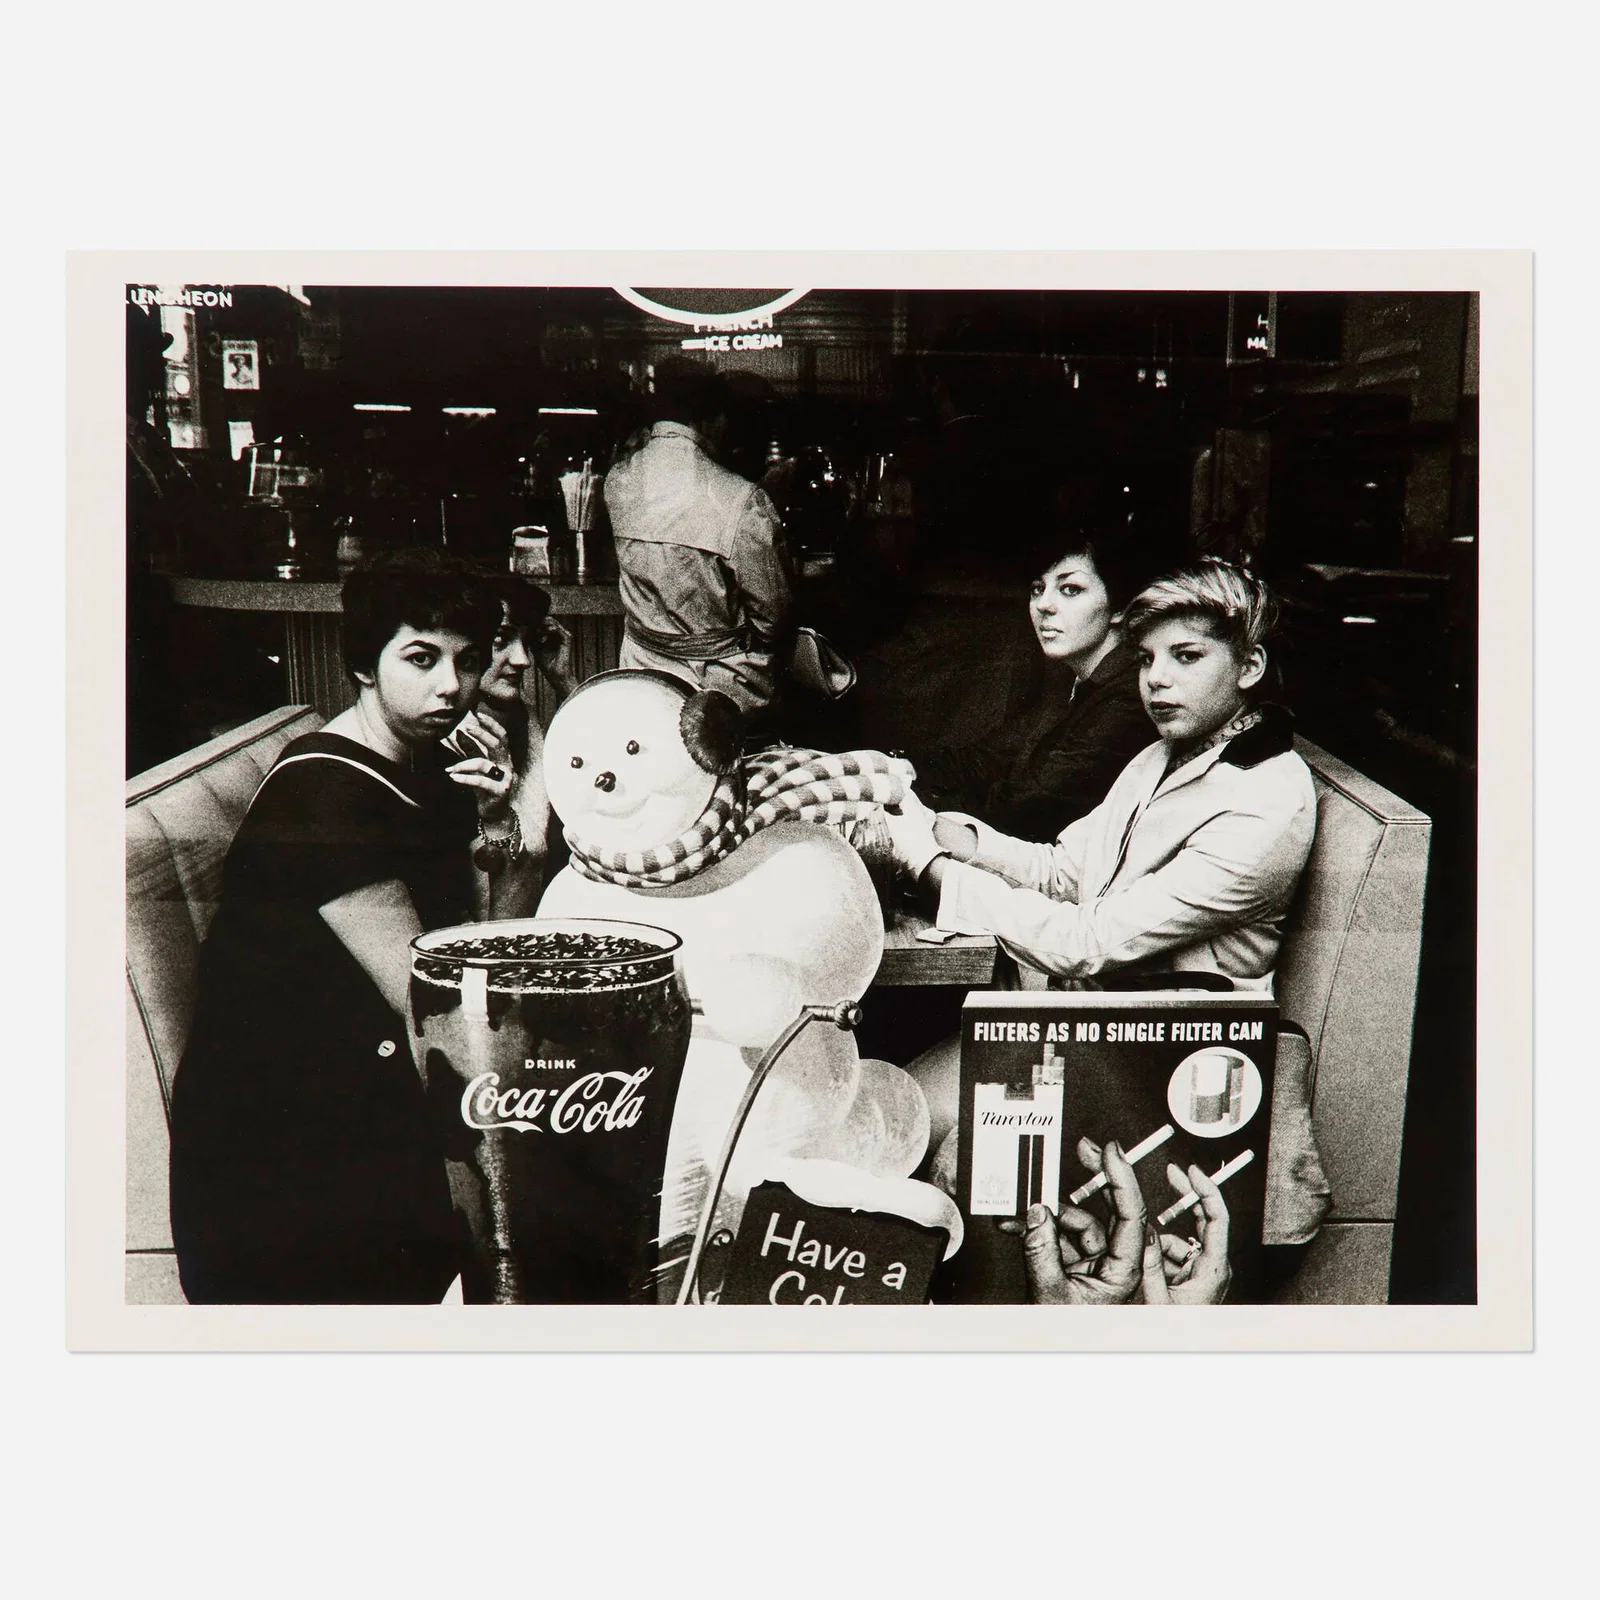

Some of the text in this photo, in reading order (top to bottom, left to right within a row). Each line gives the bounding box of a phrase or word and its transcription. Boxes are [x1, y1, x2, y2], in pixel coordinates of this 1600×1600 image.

[125, 288, 233, 308] UNHEON
[705, 333, 783, 351] ICE CREAM
[974, 1021, 1263, 1042] FILTERS AS NO SINGLE FILTER CAN
[524, 1058, 576, 1070] DRINK
[460, 1066, 655, 1134] Coca-Cola
[760, 1212, 866, 1278] Have
[881, 1261, 907, 1290] a
